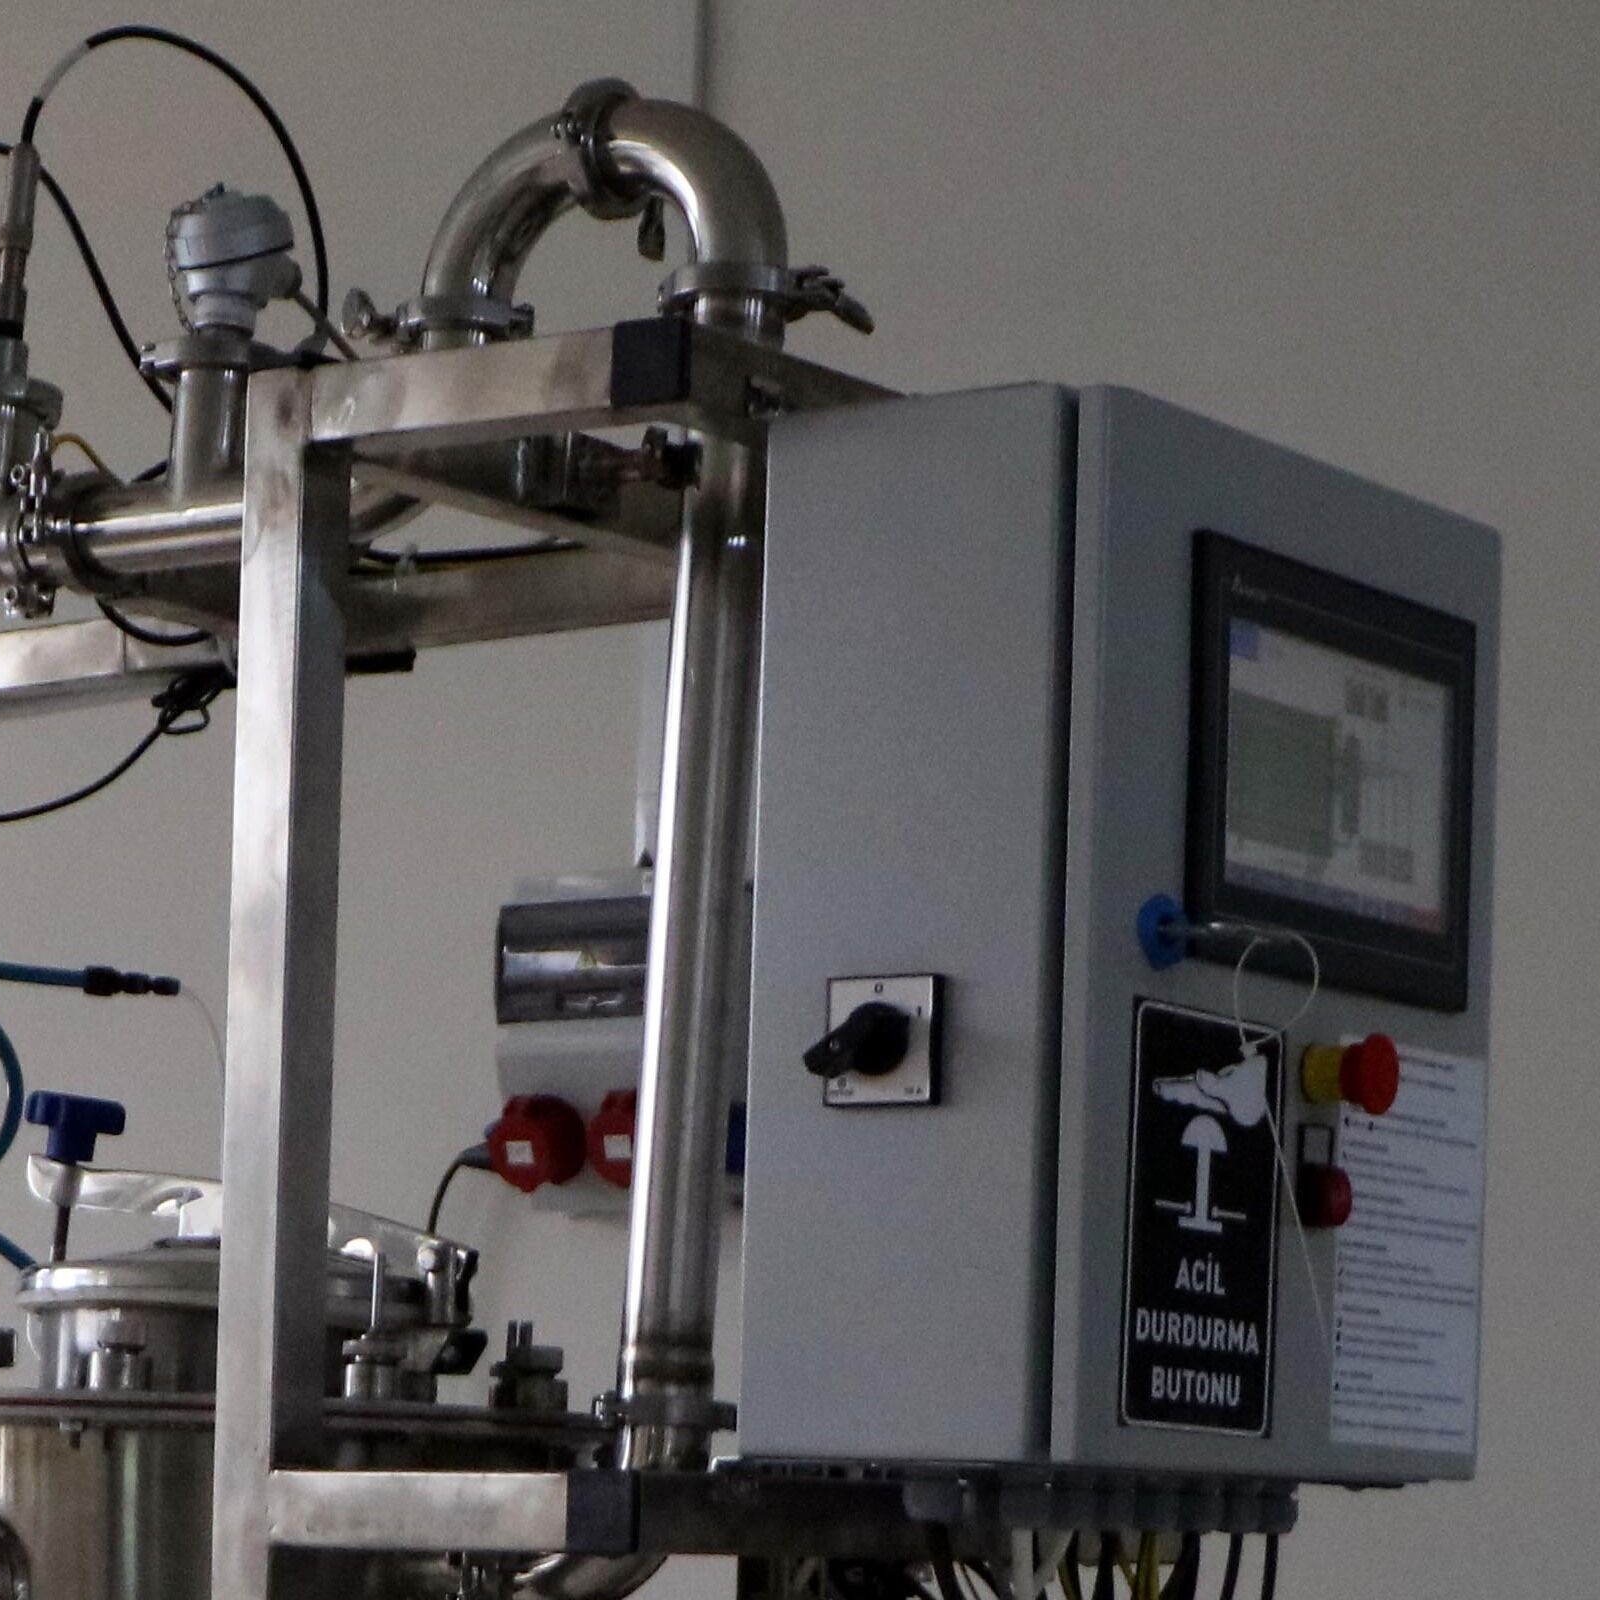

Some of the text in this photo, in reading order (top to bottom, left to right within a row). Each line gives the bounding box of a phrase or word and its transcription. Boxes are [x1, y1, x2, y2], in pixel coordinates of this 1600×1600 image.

[1174, 1251, 1227, 1297] ACİL
[1134, 1306, 1260, 1356] DURDURMA
[1150, 1364, 1242, 1408] BUTONU
